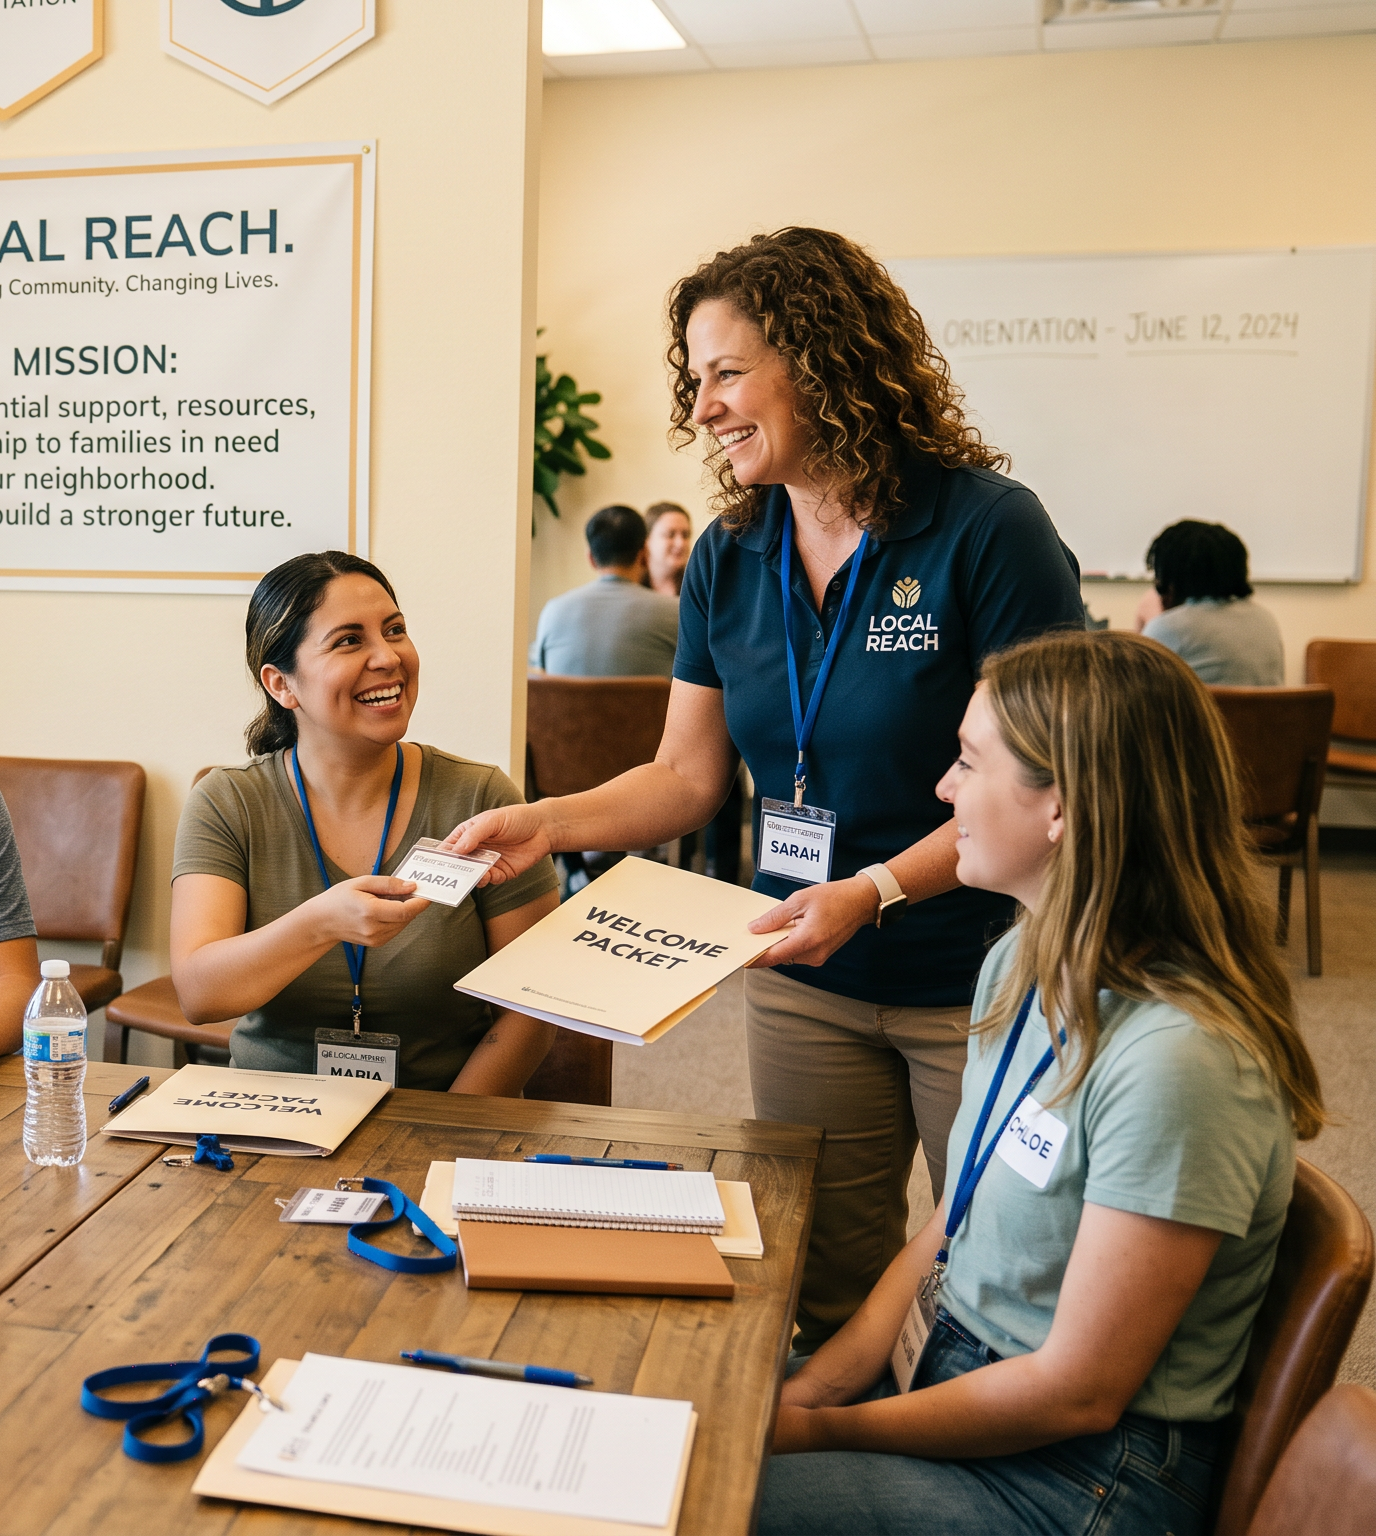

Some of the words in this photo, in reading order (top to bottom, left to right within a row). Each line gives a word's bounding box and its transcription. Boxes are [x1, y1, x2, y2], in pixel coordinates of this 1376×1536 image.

[85, 208, 294, 261] REACH.
[8, 275, 119, 298] Community.
[125, 272, 218, 296] Changing
[224, 270, 279, 290] Lives.
[943, 316, 1098, 348] ORIENTATION
[1124, 311, 1188, 345] JUNE
[1201, 313, 1231, 343] 12,
[1238, 311, 1300, 341] 2024
[13, 344, 178, 377] MISSION:
[58, 394, 168, 424] support,
[176, 396, 316, 420] resources,
[35, 432, 61, 454] to
[69, 429, 172, 454] families
[181, 429, 204, 453] in
[214, 428, 280, 454] need
[24, 465, 216, 497] neighborhood.
[59, 508, 73, 526] a
[82, 504, 196, 534] stronger
[202, 502, 293, 528] future.
[868, 613, 939, 632] LOCAL
[865, 633, 939, 652] REACH
[770, 840, 821, 863] SARAH
[408, 870, 459, 889] MARIA
[585, 906, 729, 958] WELCOME
[572, 930, 689, 970] PACKET
[330, 1066, 383, 1081] MARIA
[173, 1098, 323, 1116] WELCOME
[201, 1090, 319, 1105] PACKET
[1009, 1116, 1053, 1159] CHLOE
